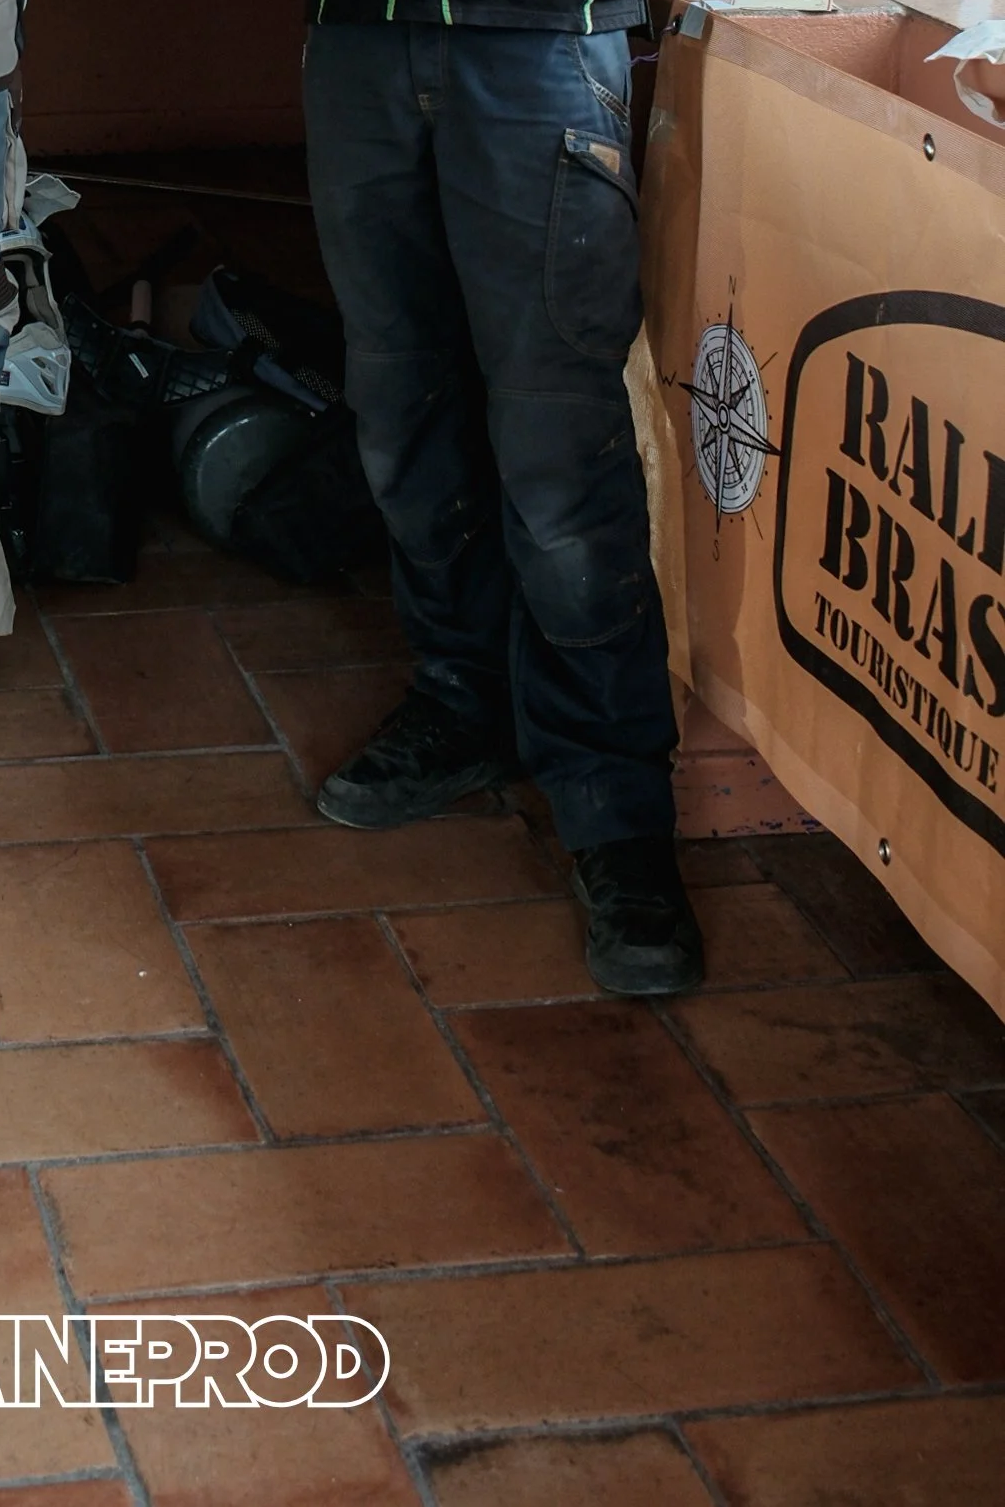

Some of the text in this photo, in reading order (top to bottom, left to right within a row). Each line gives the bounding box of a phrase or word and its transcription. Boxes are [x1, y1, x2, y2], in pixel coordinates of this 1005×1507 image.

[728, 275, 736, 296] N
[659, 368, 677, 387] W
[712, 540, 720, 561] S
[819, 467, 1005, 718] BRAS
[814, 591, 999, 794] TOURISTIQUE
